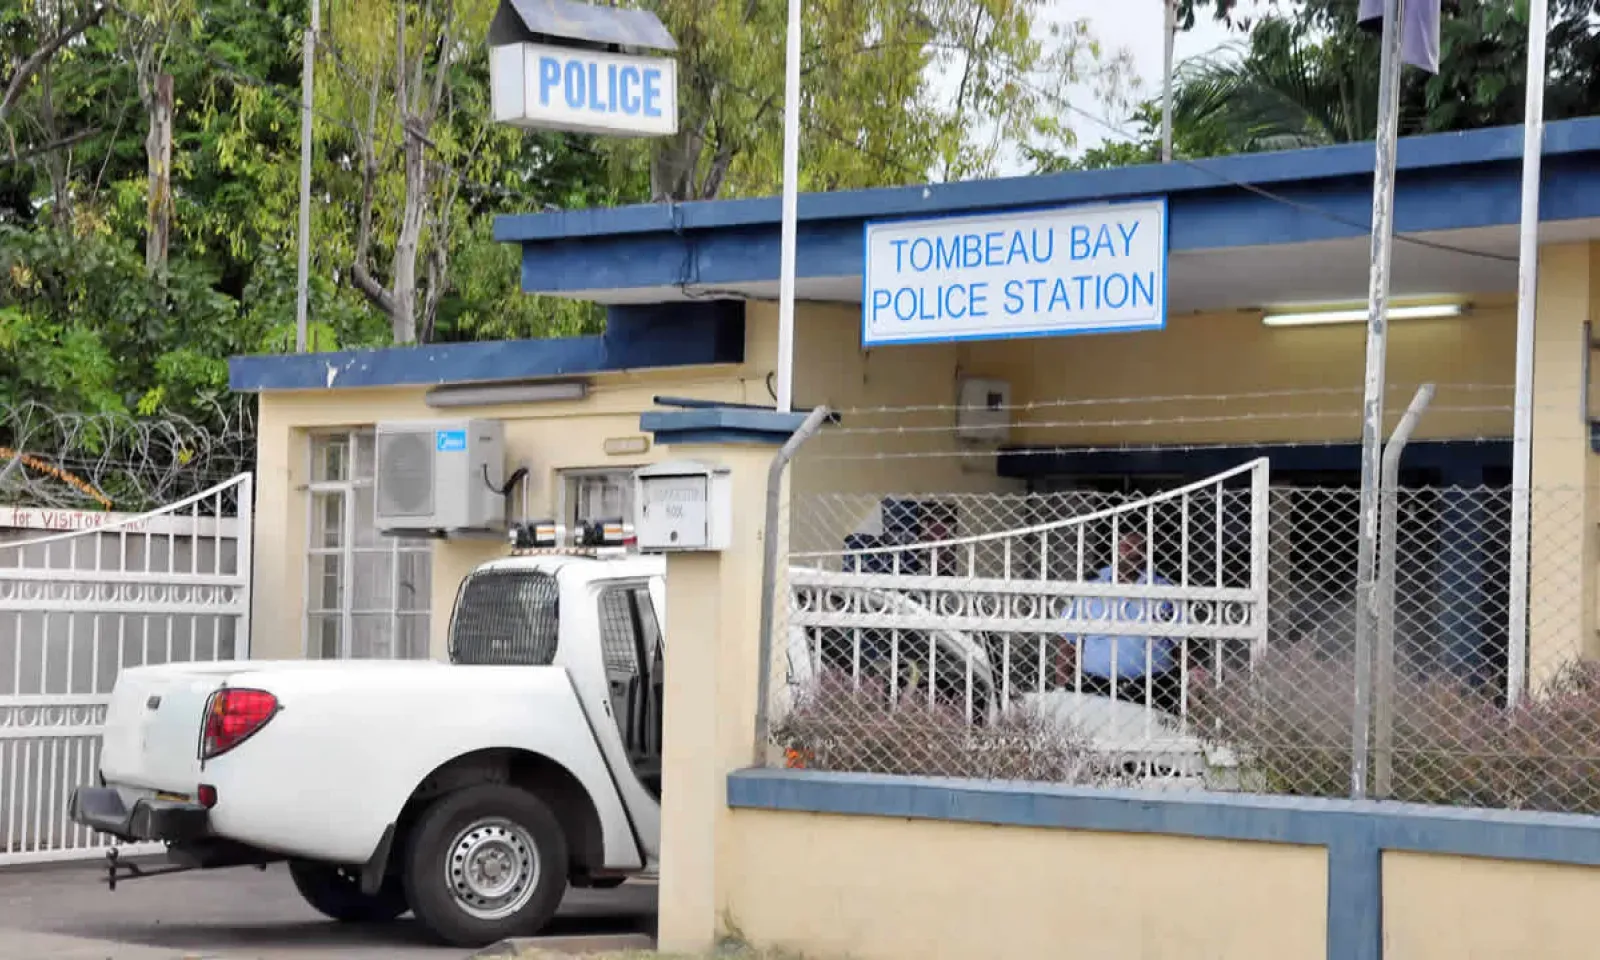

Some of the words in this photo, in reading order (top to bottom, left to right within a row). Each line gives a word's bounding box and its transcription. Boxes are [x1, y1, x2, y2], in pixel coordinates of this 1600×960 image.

[539, 56, 662, 117] POLICE
[890, 228, 1054, 273] TOMBEAU
[1070, 220, 1139, 261] BAY
[873, 282, 989, 322] POLICE
[1003, 271, 1154, 315] STATION
